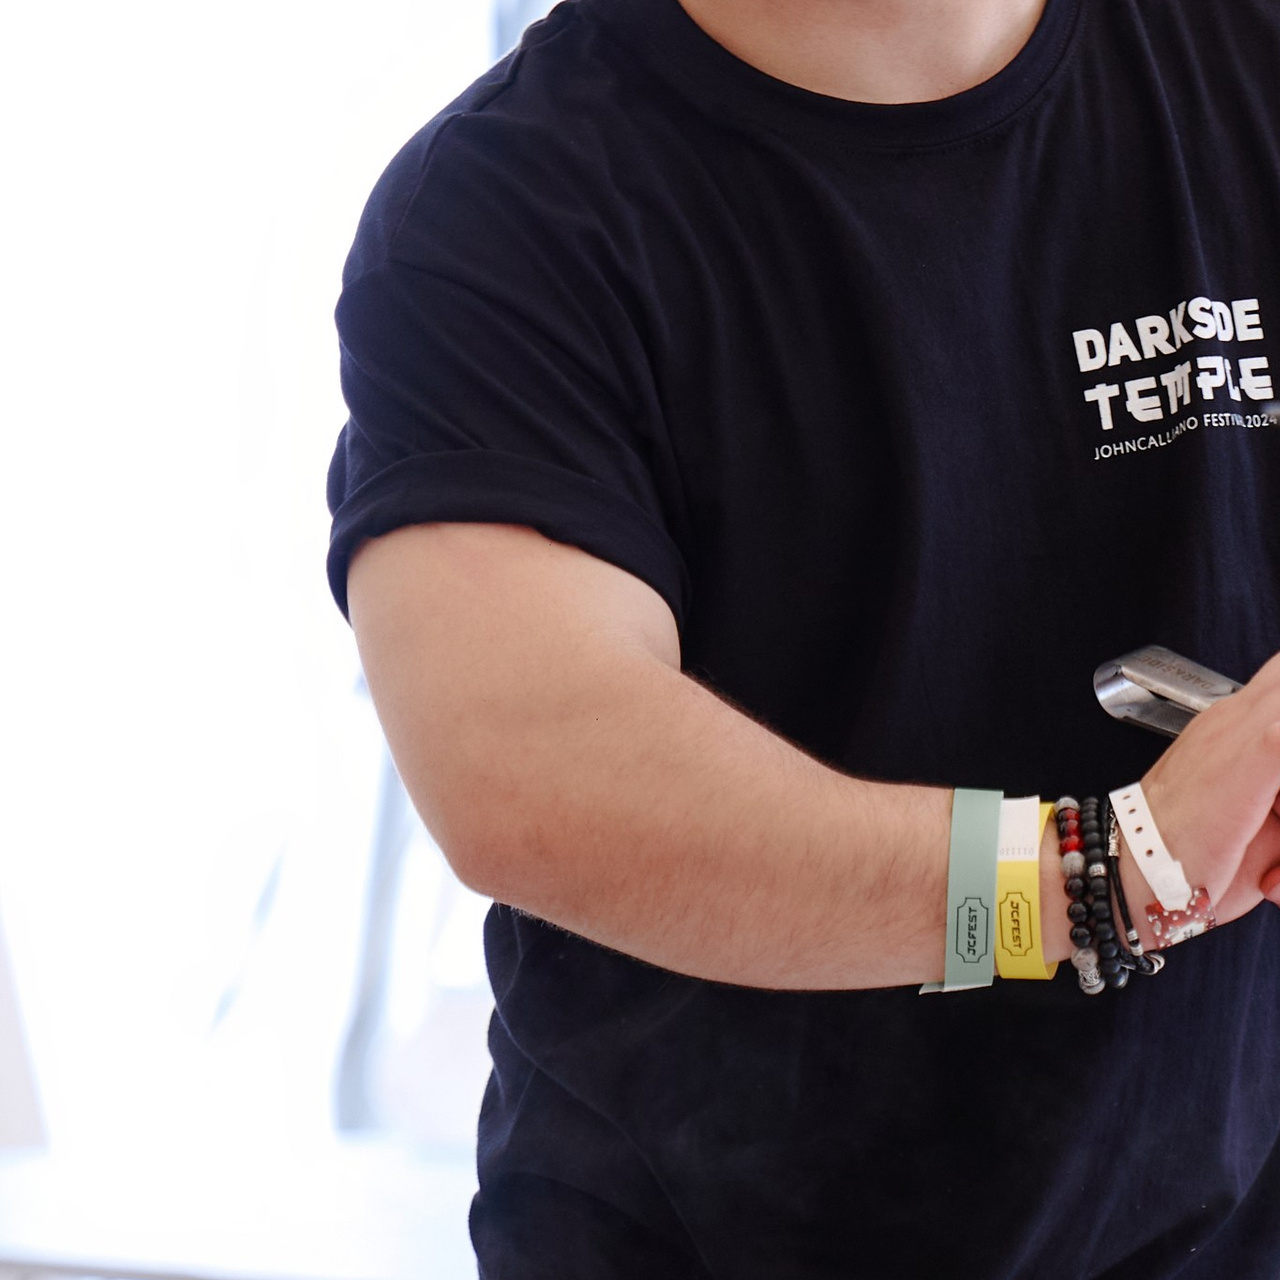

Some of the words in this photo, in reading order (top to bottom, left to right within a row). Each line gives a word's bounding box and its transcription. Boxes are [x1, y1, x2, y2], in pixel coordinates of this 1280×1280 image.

[1072, 296, 1264, 373] DARKSDE
[1084, 355, 1275, 431] TEMPLE
[1245, 413, 1278, 428] 2024
[967, 906, 978, 957] JCFEST
[1010, 901, 1022, 950] JCFEST
